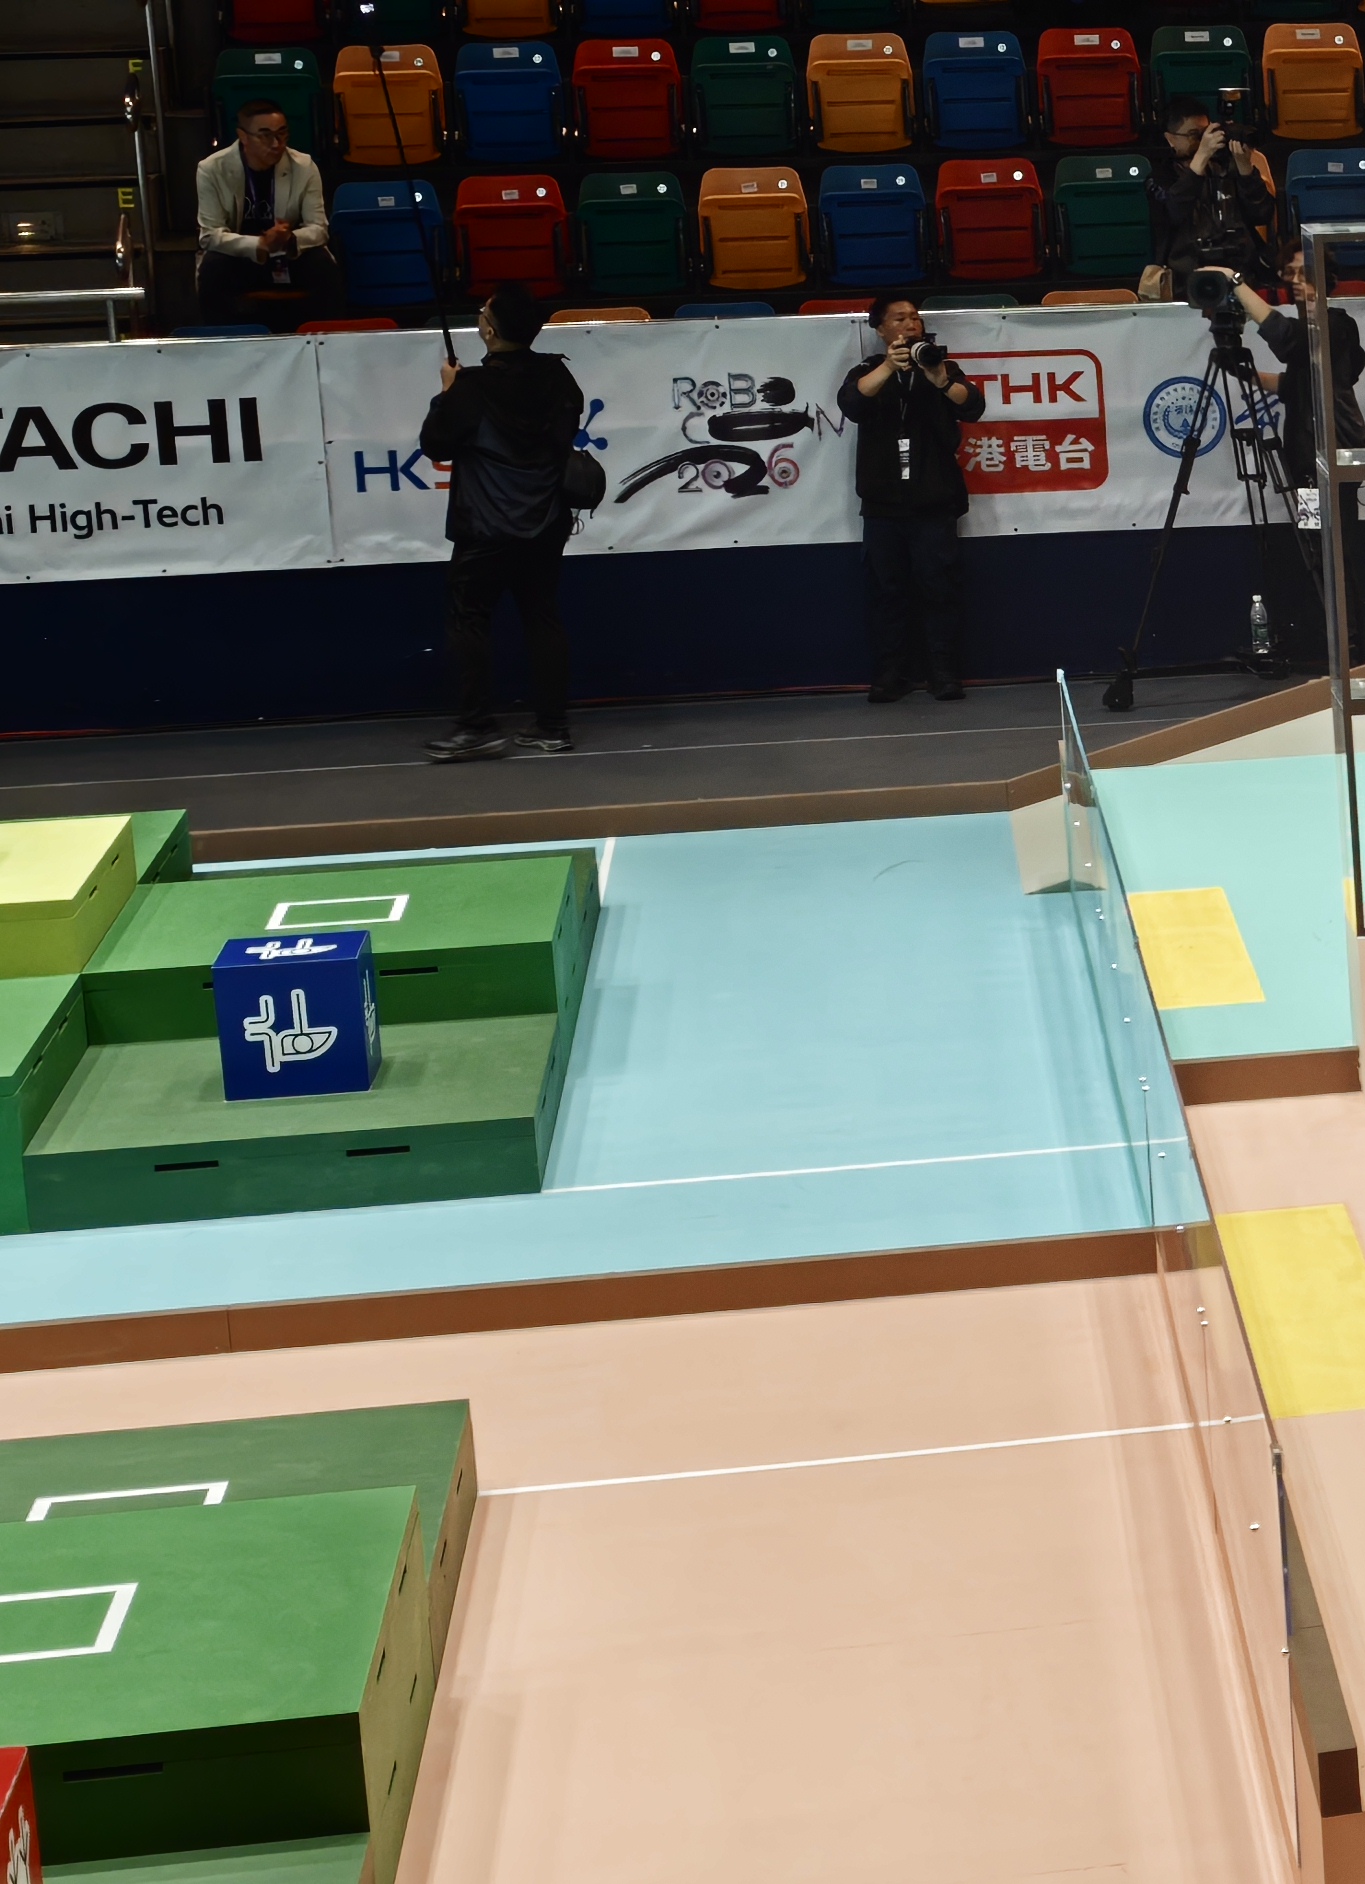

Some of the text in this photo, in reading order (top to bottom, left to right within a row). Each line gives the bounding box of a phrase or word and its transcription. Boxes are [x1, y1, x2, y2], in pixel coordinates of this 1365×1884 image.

[118, 188, 134, 208] E
[0, 397, 263, 472] ACHI
[955, 434, 1095, 472] 港電台
[29, 496, 224, 539] High-Tech
